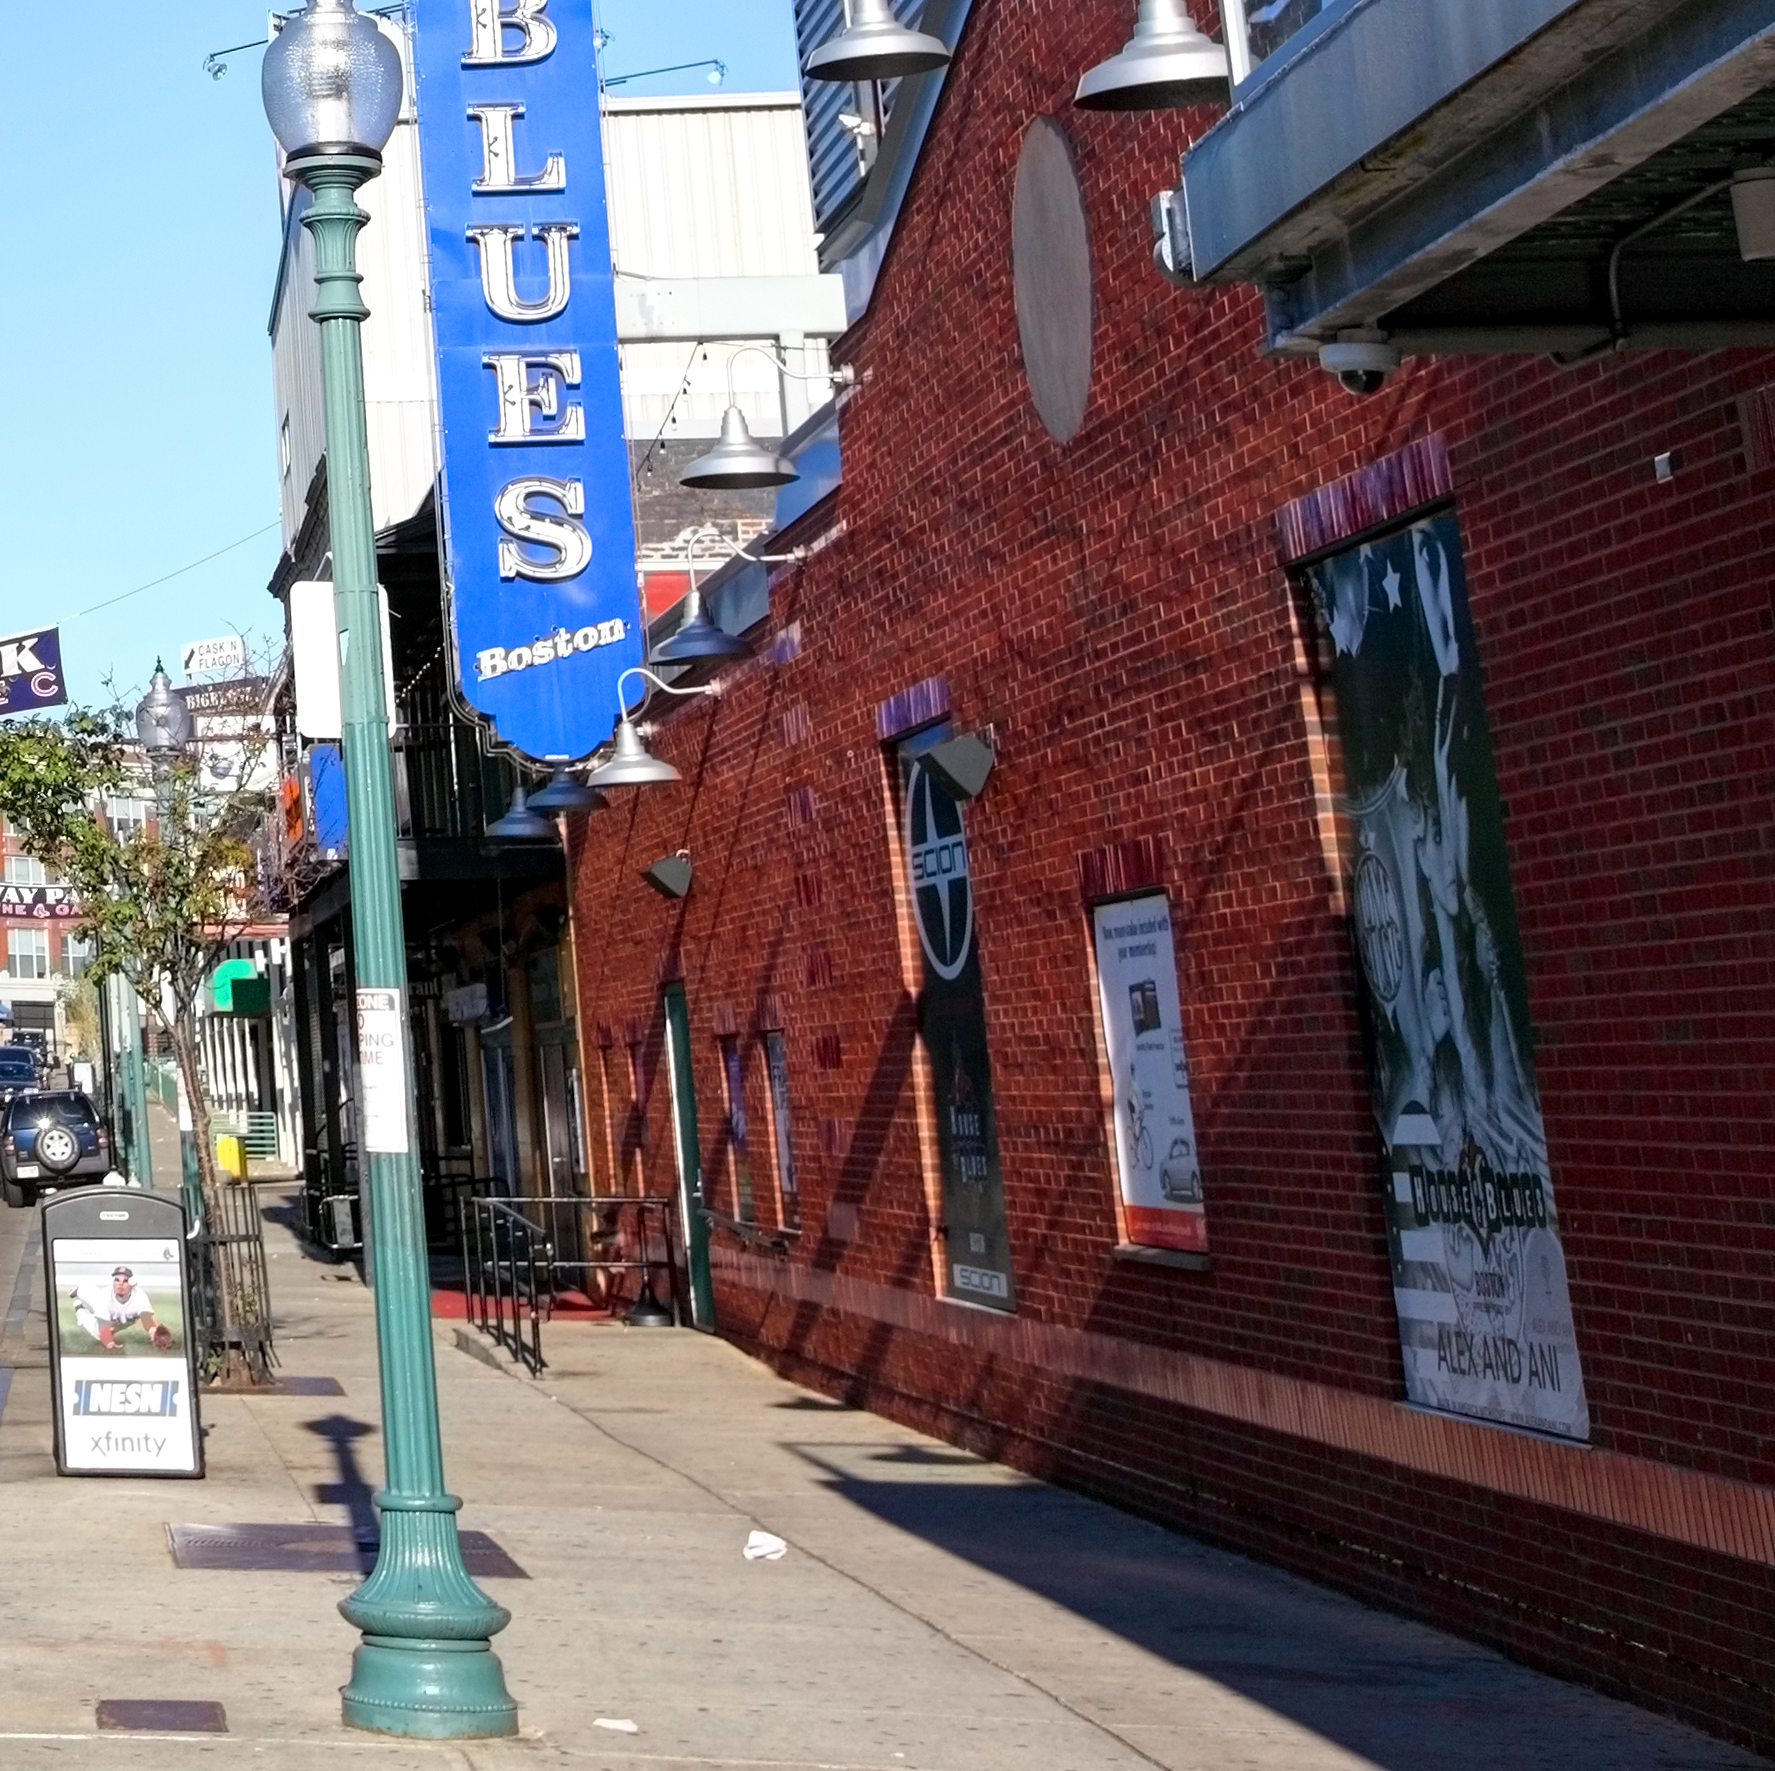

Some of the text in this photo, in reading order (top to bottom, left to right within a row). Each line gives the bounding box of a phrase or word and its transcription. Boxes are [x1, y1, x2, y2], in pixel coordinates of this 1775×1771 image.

[198, 641, 225, 657] CASK
[198, 653, 240, 670] FLAGON
[476, 616, 628, 682] Boston
[30, 671, 59, 698] C
[359, 1033, 394, 1048] PING
[1413, 1176, 1471, 1214] HOUSE
[1484, 1181, 1544, 1220] BLUES
[1437, 1327, 1562, 1393] ALEX AND ANI
[88, 1382, 164, 1414] NESN
[90, 1431, 167, 1458] xfinity
